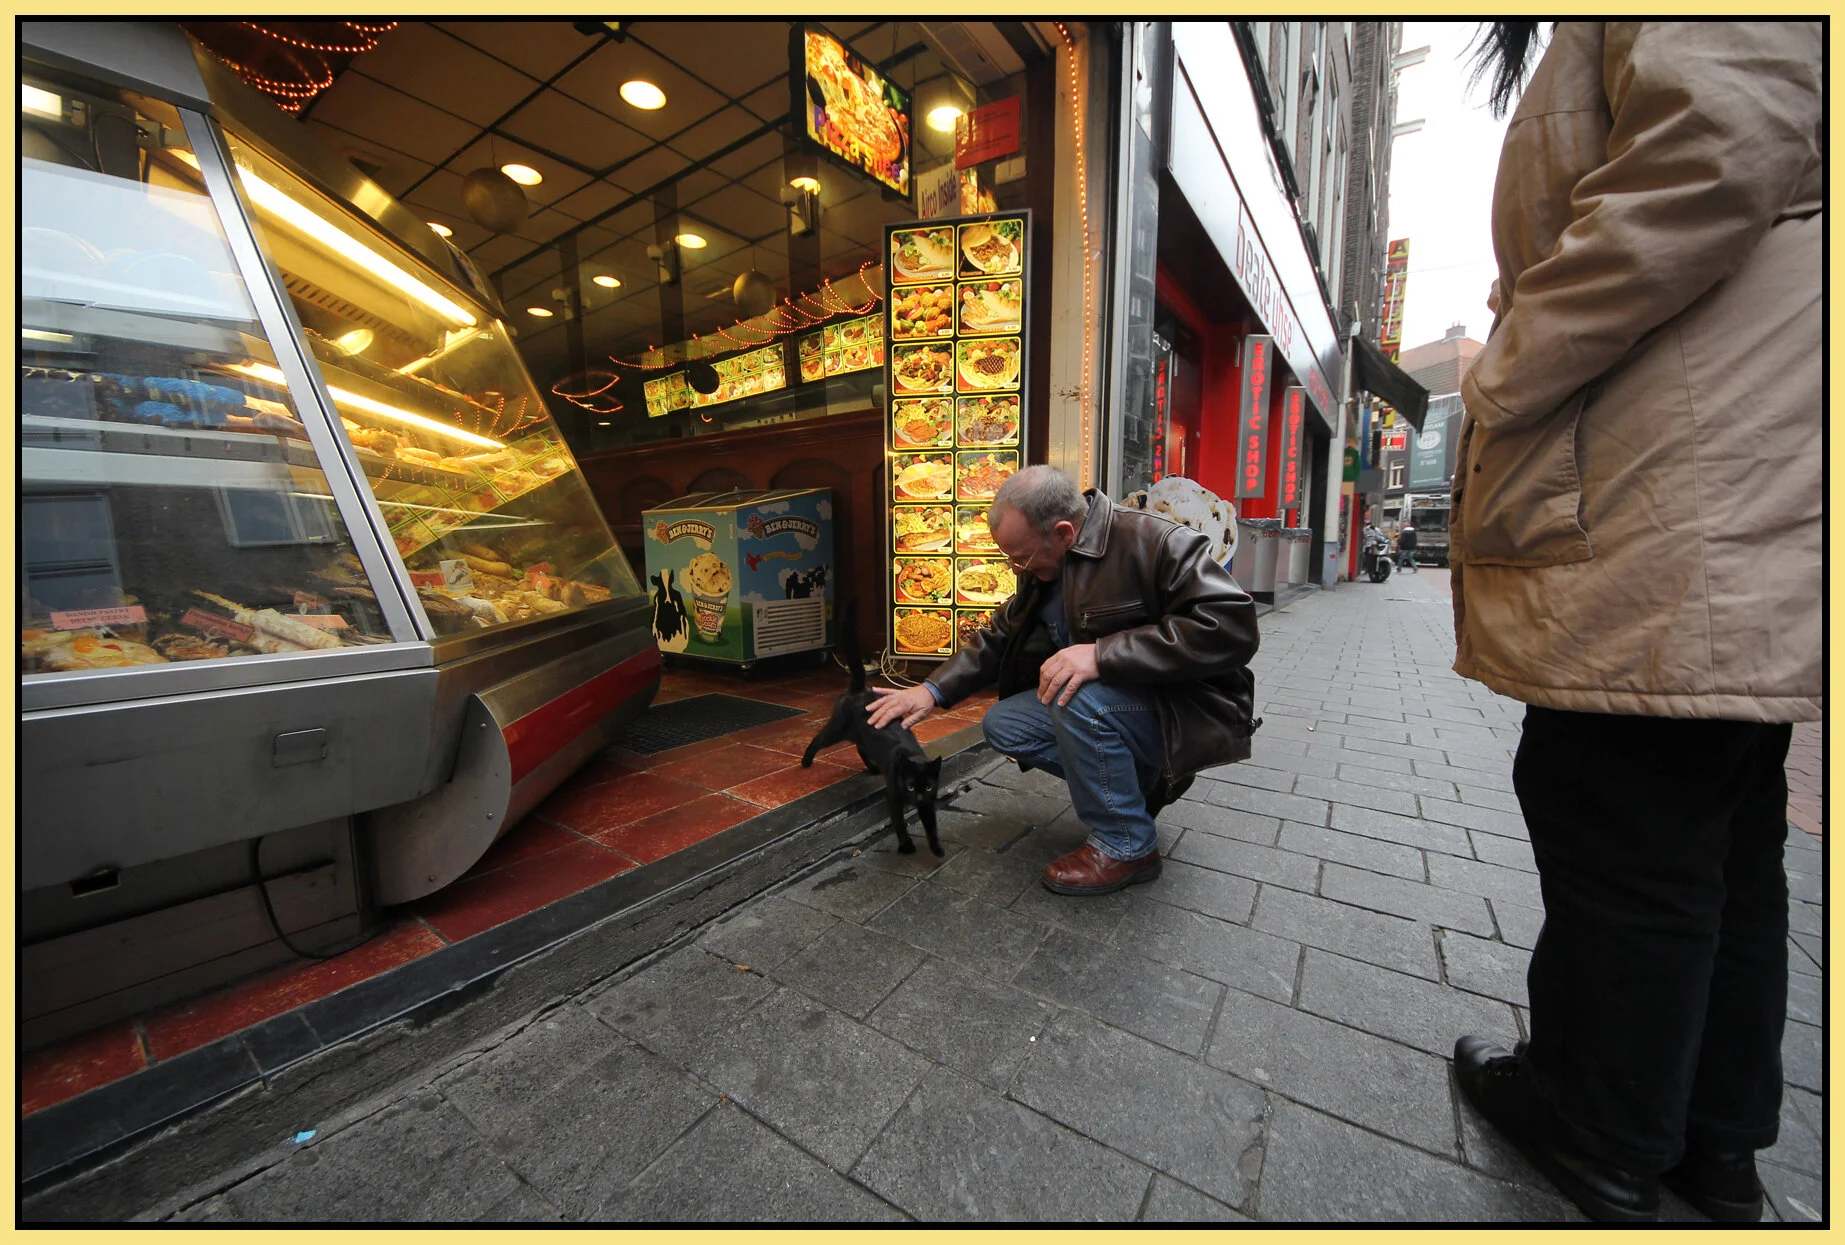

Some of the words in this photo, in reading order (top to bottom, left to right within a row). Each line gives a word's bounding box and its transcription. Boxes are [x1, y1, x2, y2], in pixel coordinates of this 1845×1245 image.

[814, 105, 860, 158] Pizza
[921, 189, 937, 218] Airco
[938, 168, 956, 210] Inside
[1235, 198, 1271, 323] beate
[1271, 285, 1293, 359] uhse
[1249, 342, 1265, 430] EROTIC
[1287, 392, 1300, 458] EROTIC
[1245, 435, 1260, 492] SHOP
[1284, 460, 1297, 503] SHOP
[669, 523, 713, 540] BEN&JERRY'S
[765, 519, 816, 535] BEN&JERRY'S
